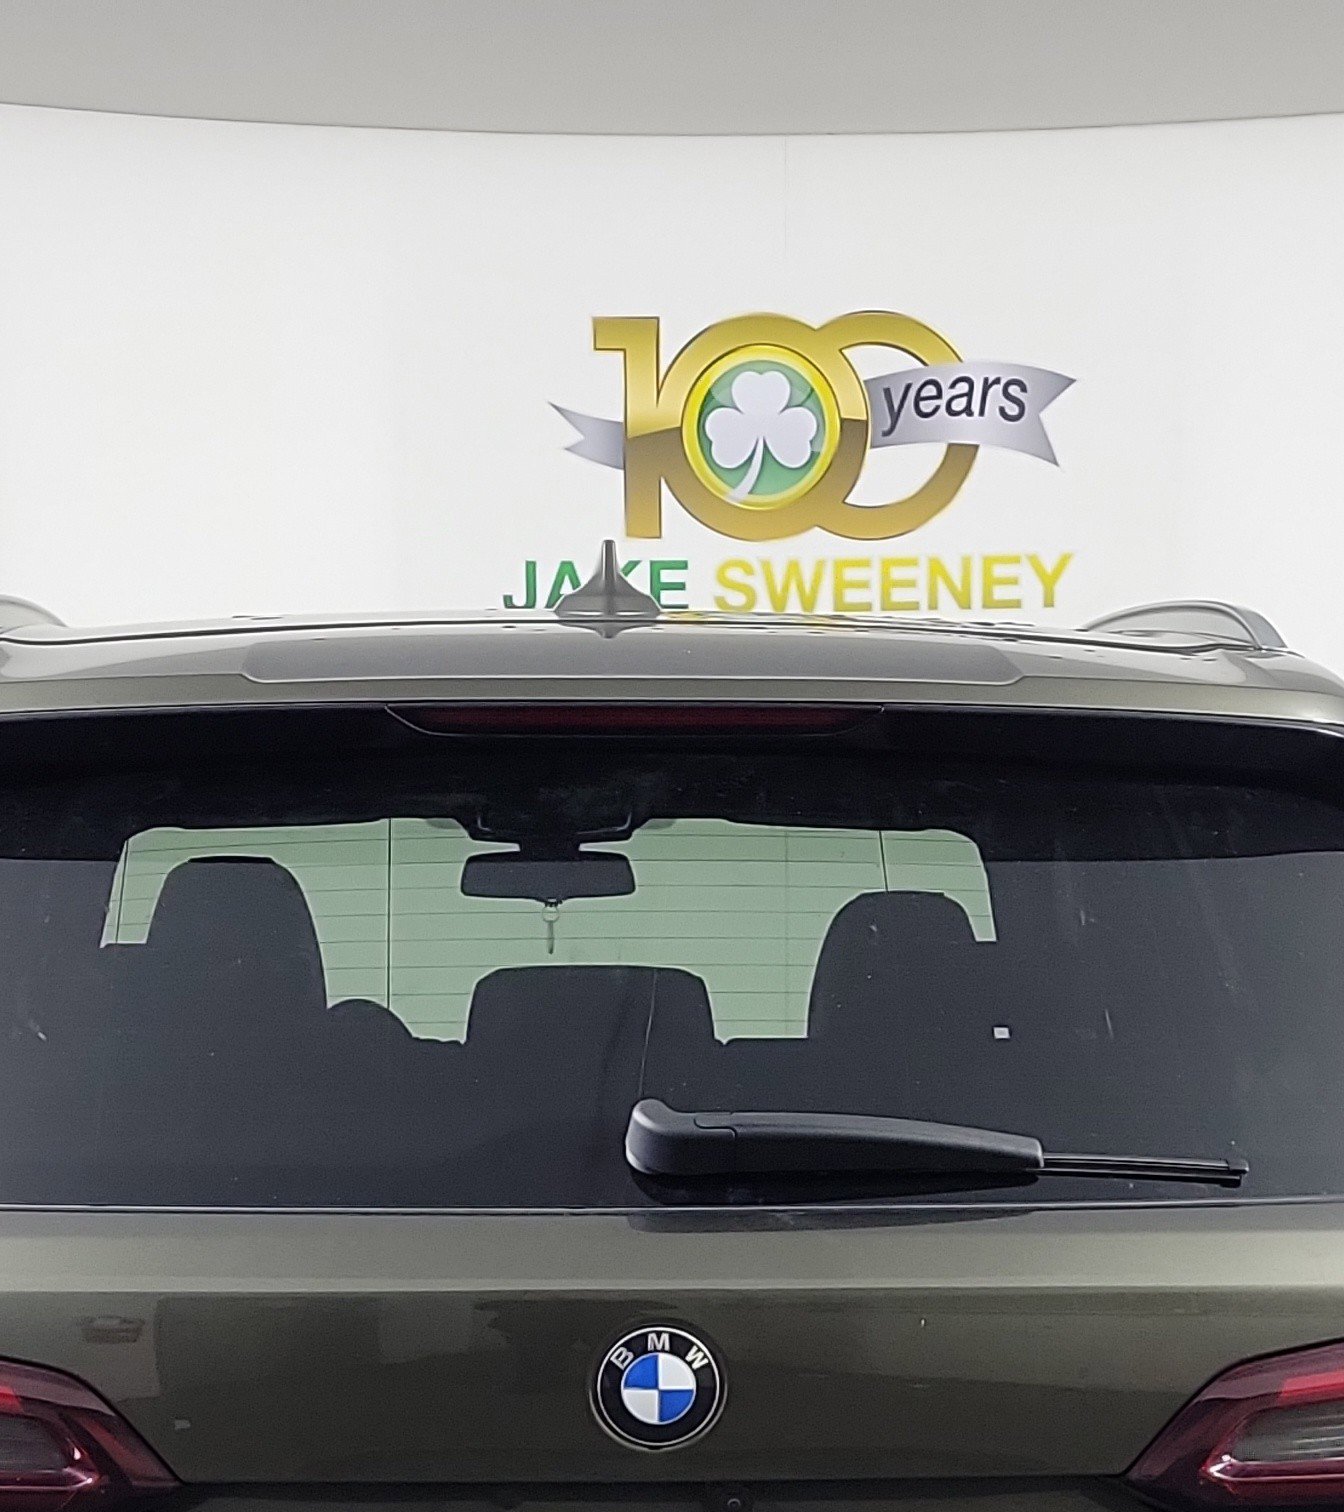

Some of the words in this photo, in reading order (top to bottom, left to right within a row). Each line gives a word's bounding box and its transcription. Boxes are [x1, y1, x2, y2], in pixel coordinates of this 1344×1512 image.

[883, 376, 1029, 437] years
[714, 552, 1074, 614] SWEENEY
[610, 1332, 709, 1370] BMW
